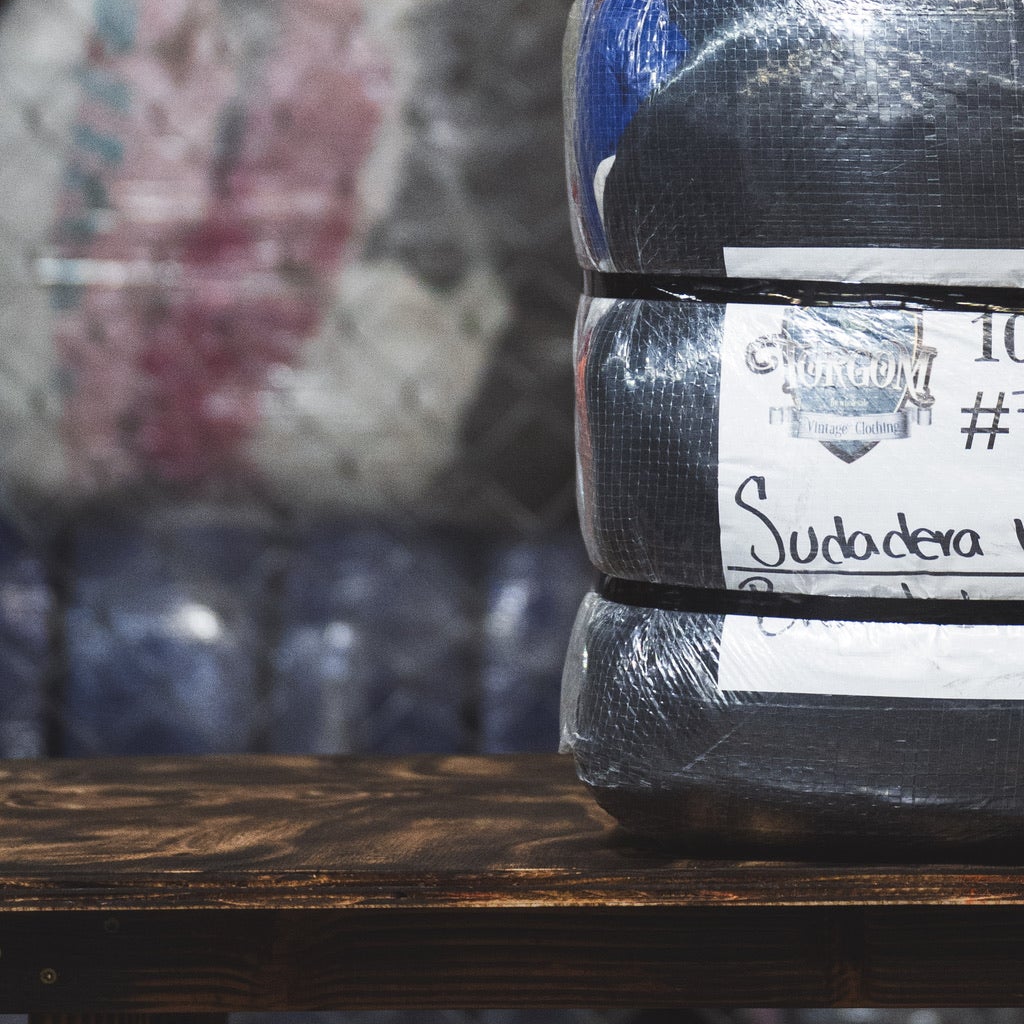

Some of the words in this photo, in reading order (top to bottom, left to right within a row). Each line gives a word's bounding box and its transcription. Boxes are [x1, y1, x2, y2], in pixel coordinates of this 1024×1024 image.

[805, 418, 848, 437] Vintage
[855, 419, 900, 436] Clothing
[734, 475, 985, 569] Sudadera
